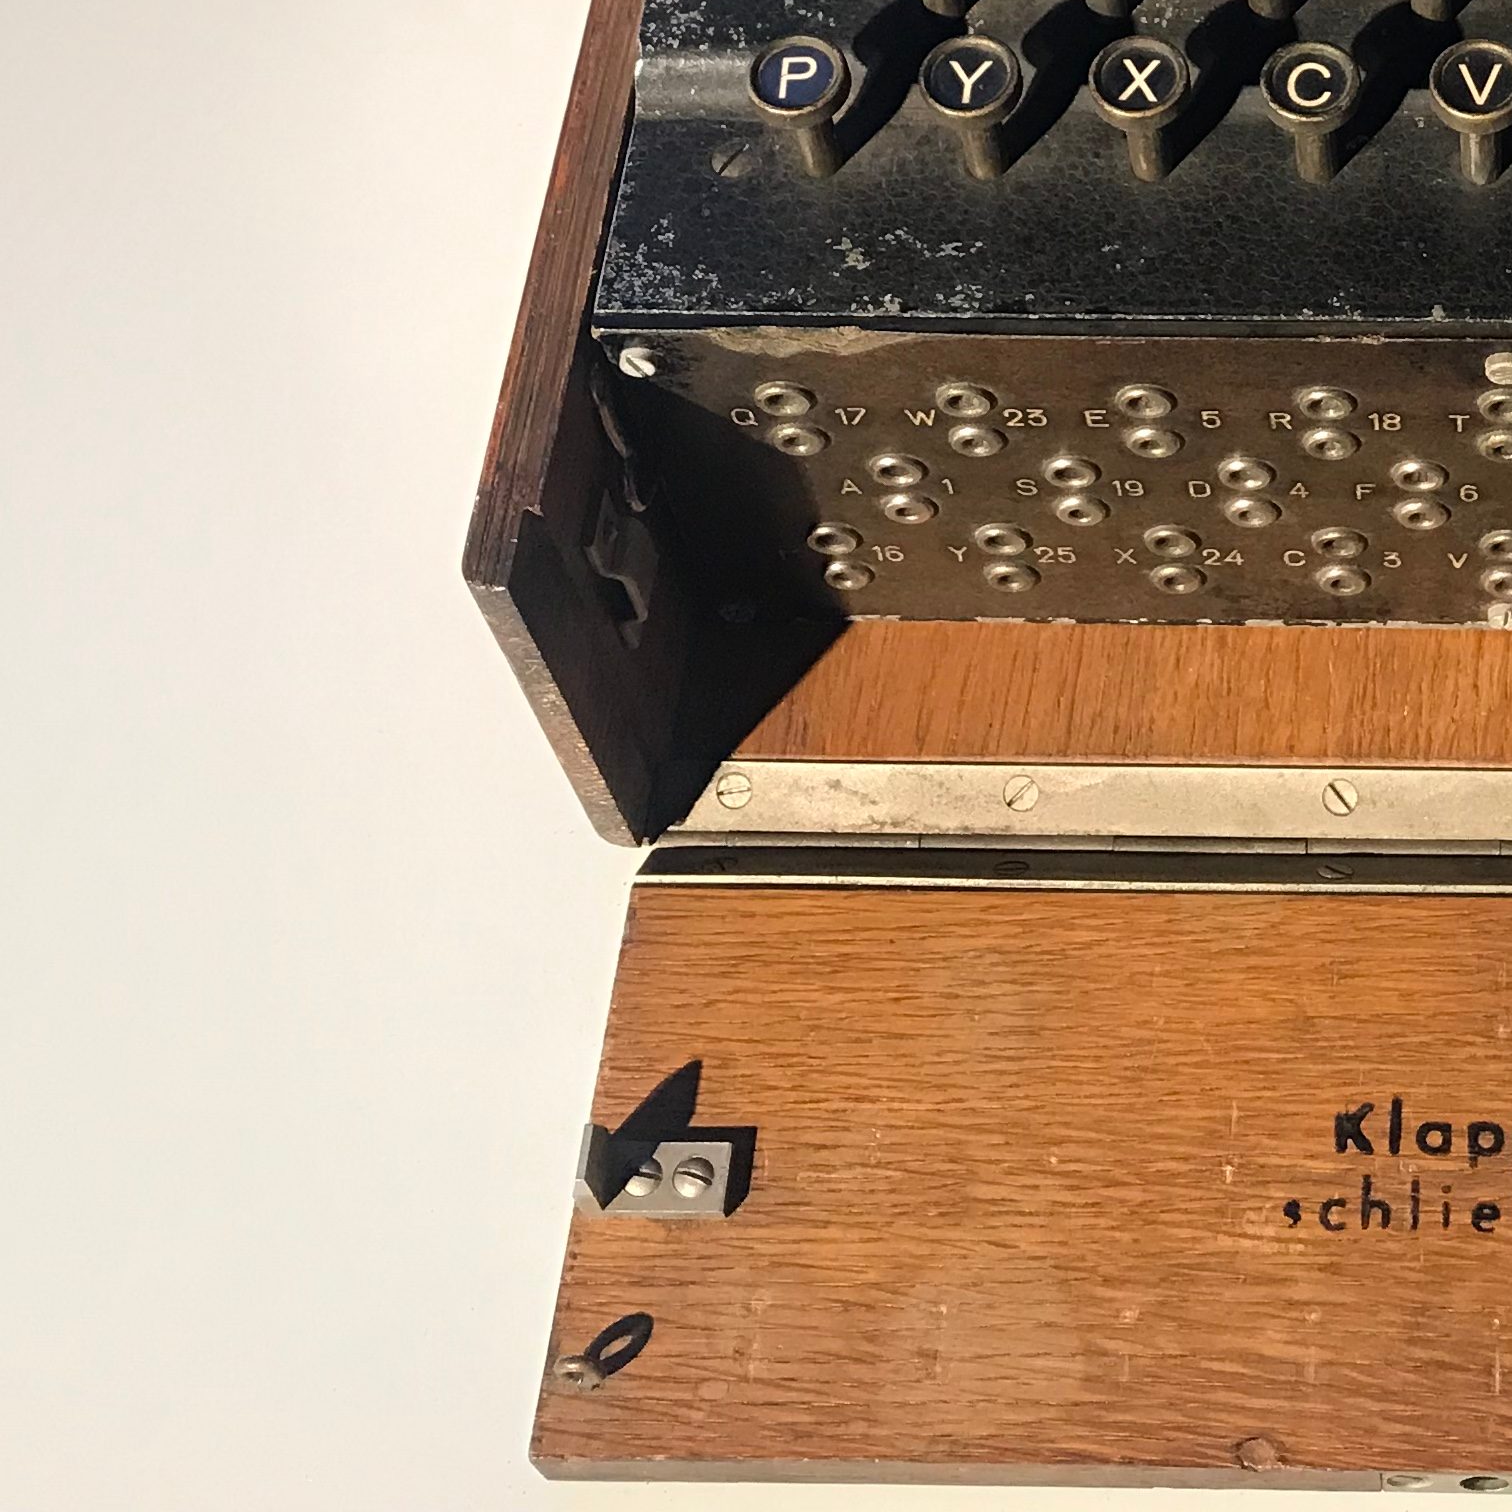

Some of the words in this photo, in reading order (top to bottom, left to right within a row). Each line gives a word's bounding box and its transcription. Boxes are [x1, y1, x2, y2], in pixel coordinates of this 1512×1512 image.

[778, 56, 818, 99] P
[948, 60, 994, 104] Y
[1118, 58, 1161, 103] X
[1286, 62, 1332, 107] C
[1458, 63, 1503, 106] V
[730, 408, 759, 428] Q
[834, 407, 867, 426] 17
[903, 409, 936, 427] W
[1002, 408, 1048, 427] 23
[1083, 409, 1110, 428] E
[1200, 410, 1221, 429] 5
[1269, 412, 1293, 430] R
[1367, 412, 1402, 431] 18
[1448, 414, 1471, 433] T
[840, 478, 863, 495] A
[941, 478, 954, 495] 1
[1015, 478, 1039, 496] S
[1111, 479, 1145, 497] 19
[1188, 480, 1212, 498] D
[1289, 482, 1310, 499] 4
[1355, 483, 1377, 500] F
[1459, 484, 1479, 503] 6
[871, 545, 905, 562] 16
[947, 546, 968, 563] Y
[1033, 546, 1077, 564] 25
[1113, 548, 1137, 565] X
[1201, 548, 1245, 566] 24
[1283, 550, 1306, 567] C
[1383, 551, 1402, 569] 3
[1447, 553, 1468, 569] V
